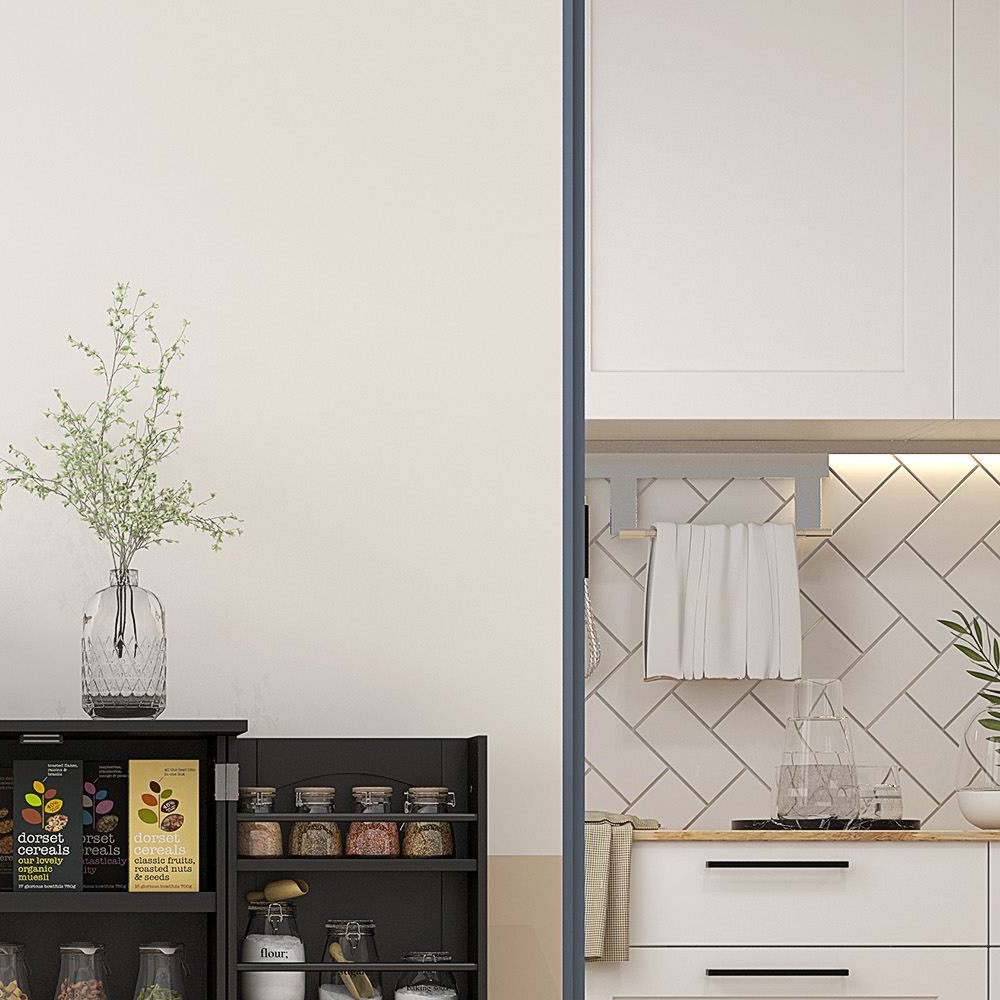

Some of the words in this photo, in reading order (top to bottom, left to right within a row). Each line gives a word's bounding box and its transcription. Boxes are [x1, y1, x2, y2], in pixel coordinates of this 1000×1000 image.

[17, 832, 64, 844] dorset
[133, 832, 180, 844] dorset
[17, 844, 70, 856] cereals
[133, 844, 186, 856] cereals
[36, 857, 64, 866] lovely
[134, 857, 166, 865] classic
[168, 857, 196, 865] fruits,
[18, 865, 53, 874] organic
